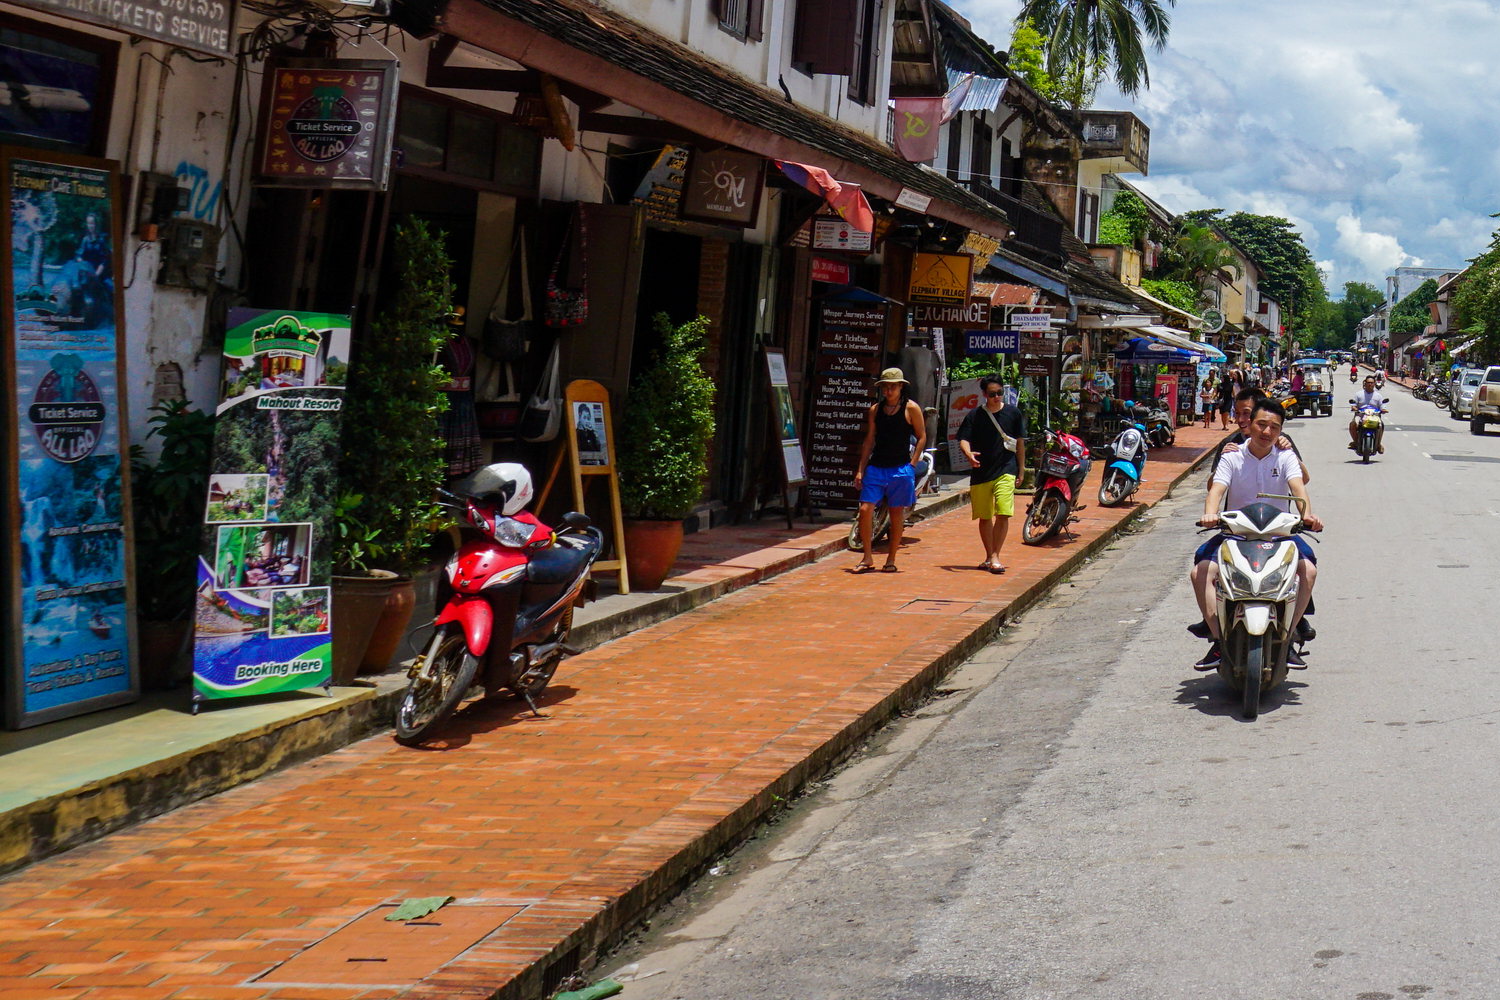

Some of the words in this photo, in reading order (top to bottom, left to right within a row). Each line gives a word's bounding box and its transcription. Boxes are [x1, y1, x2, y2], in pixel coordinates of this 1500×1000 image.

[171, 15, 228, 51] SERVICE
[296, 122, 321, 131] Ticket
[323, 123, 353, 132] Service
[296, 138, 317, 158] ALL
[320, 140, 345, 159] LAO
[910, 285, 941, 296] ELEPHANT
[941, 288, 966, 298] VILLAGE
[823, 309, 843, 318] Whisper
[844, 310, 865, 320] Journeys
[866, 311, 884, 320] Service
[914, 303, 988, 323] EXCHANGE
[834, 333, 843, 341] Air
[845, 333, 868, 344] Ticketing
[969, 335, 1016, 349] EXCHANGE
[821, 341, 843, 349] Domestic
[848, 343, 879, 351] International
[838, 357, 858, 365] VISA
[842, 379, 863, 387] Service
[259, 398, 301, 408] Mahout
[303, 399, 340, 409] Resort
[855, 400, 872, 408] Rental
[951, 394, 979, 411] 4G
[38, 407, 67, 419] Ticket
[67, 406, 98, 419] Service
[838, 411, 864, 419] Waterfall
[836, 423, 860, 431] Waterfall
[813, 432, 825, 441] City
[41, 429, 67, 458] ALL
[69, 429, 95, 459] LAO
[813, 443, 835, 452] Elephant
[810, 466, 837, 475] Adventure
[808, 489, 829, 498] Cooking
[829, 490, 844, 498] Class
[237, 663, 290, 678] Booking
[292, 660, 321, 672] Here
